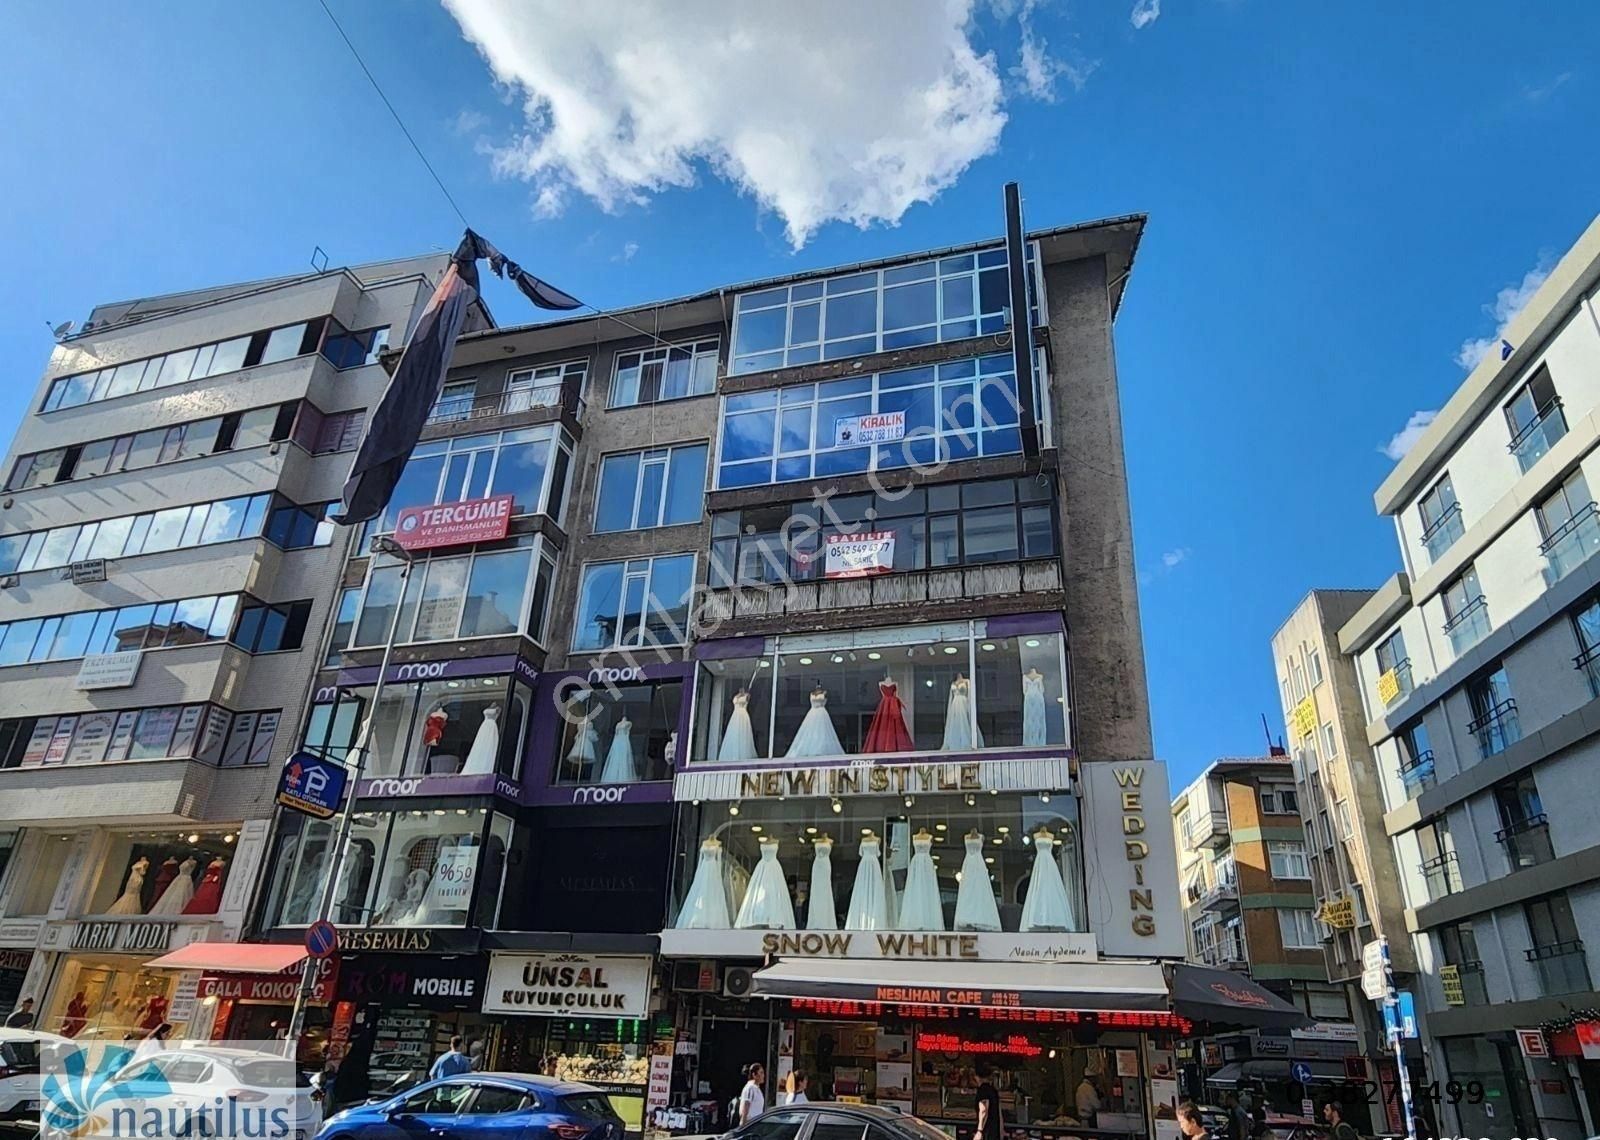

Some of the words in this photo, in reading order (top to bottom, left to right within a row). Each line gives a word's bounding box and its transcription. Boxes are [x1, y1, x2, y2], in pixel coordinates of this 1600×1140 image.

[422, 499, 508, 526] TERCÜME
[422, 528, 433, 536] VE
[830, 530, 893, 543] SATILIK
[741, 767, 817, 797] NEW
[829, 769, 861, 794] IN
[869, 763, 981, 792] STYLE
[1112, 767, 1156, 938] WEDDING
[762, 933, 853, 956] SNOW
[876, 934, 980, 957] WHITE
[522, 961, 609, 988] ÜNSAL
[204, 981, 242, 997] GALA
[413, 978, 475, 996] MOBILE
[877, 987, 941, 1003] NESLİHAN
[947, 991, 982, 1004] CAFE
[502, 990, 626, 1009] KUYUMCULUK
